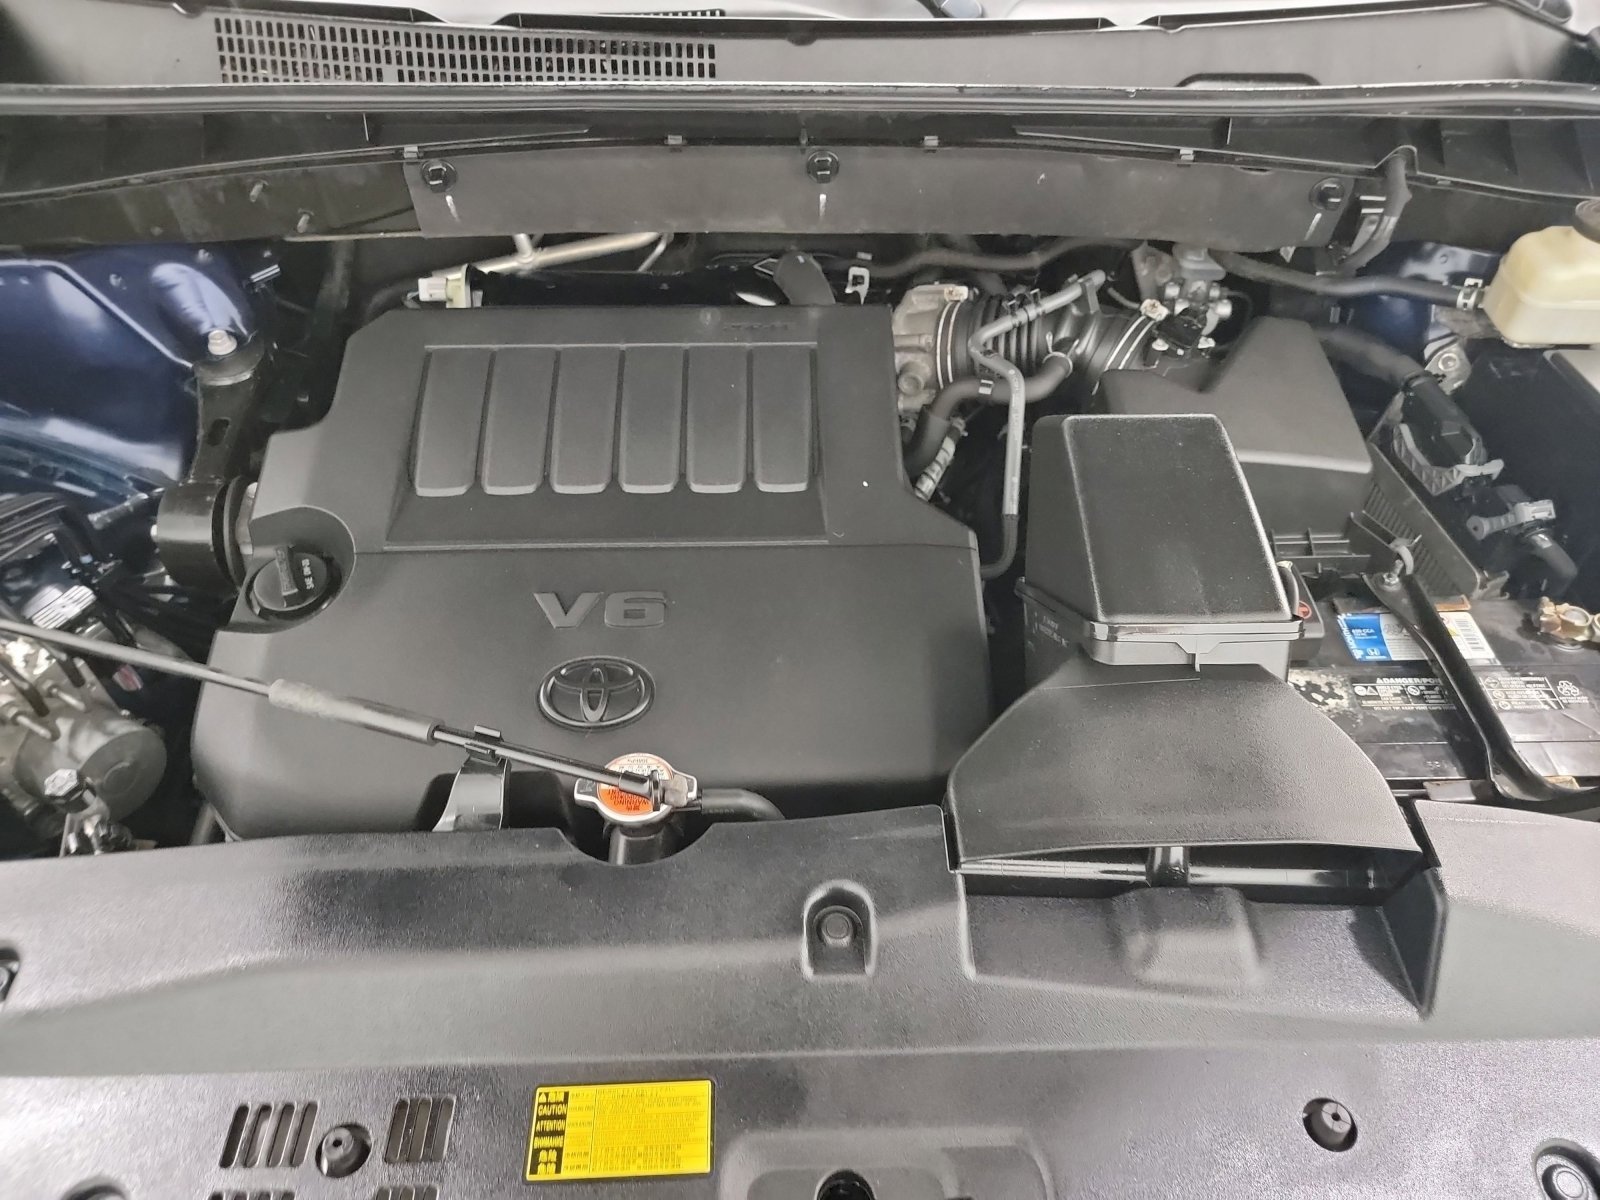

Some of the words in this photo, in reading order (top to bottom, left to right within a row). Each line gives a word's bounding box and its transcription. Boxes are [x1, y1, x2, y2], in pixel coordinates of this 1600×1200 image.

[532, 590, 666, 630] V6
[537, 1103, 568, 1117] CAUTION
[535, 1119, 566, 1132] ATTENTION
